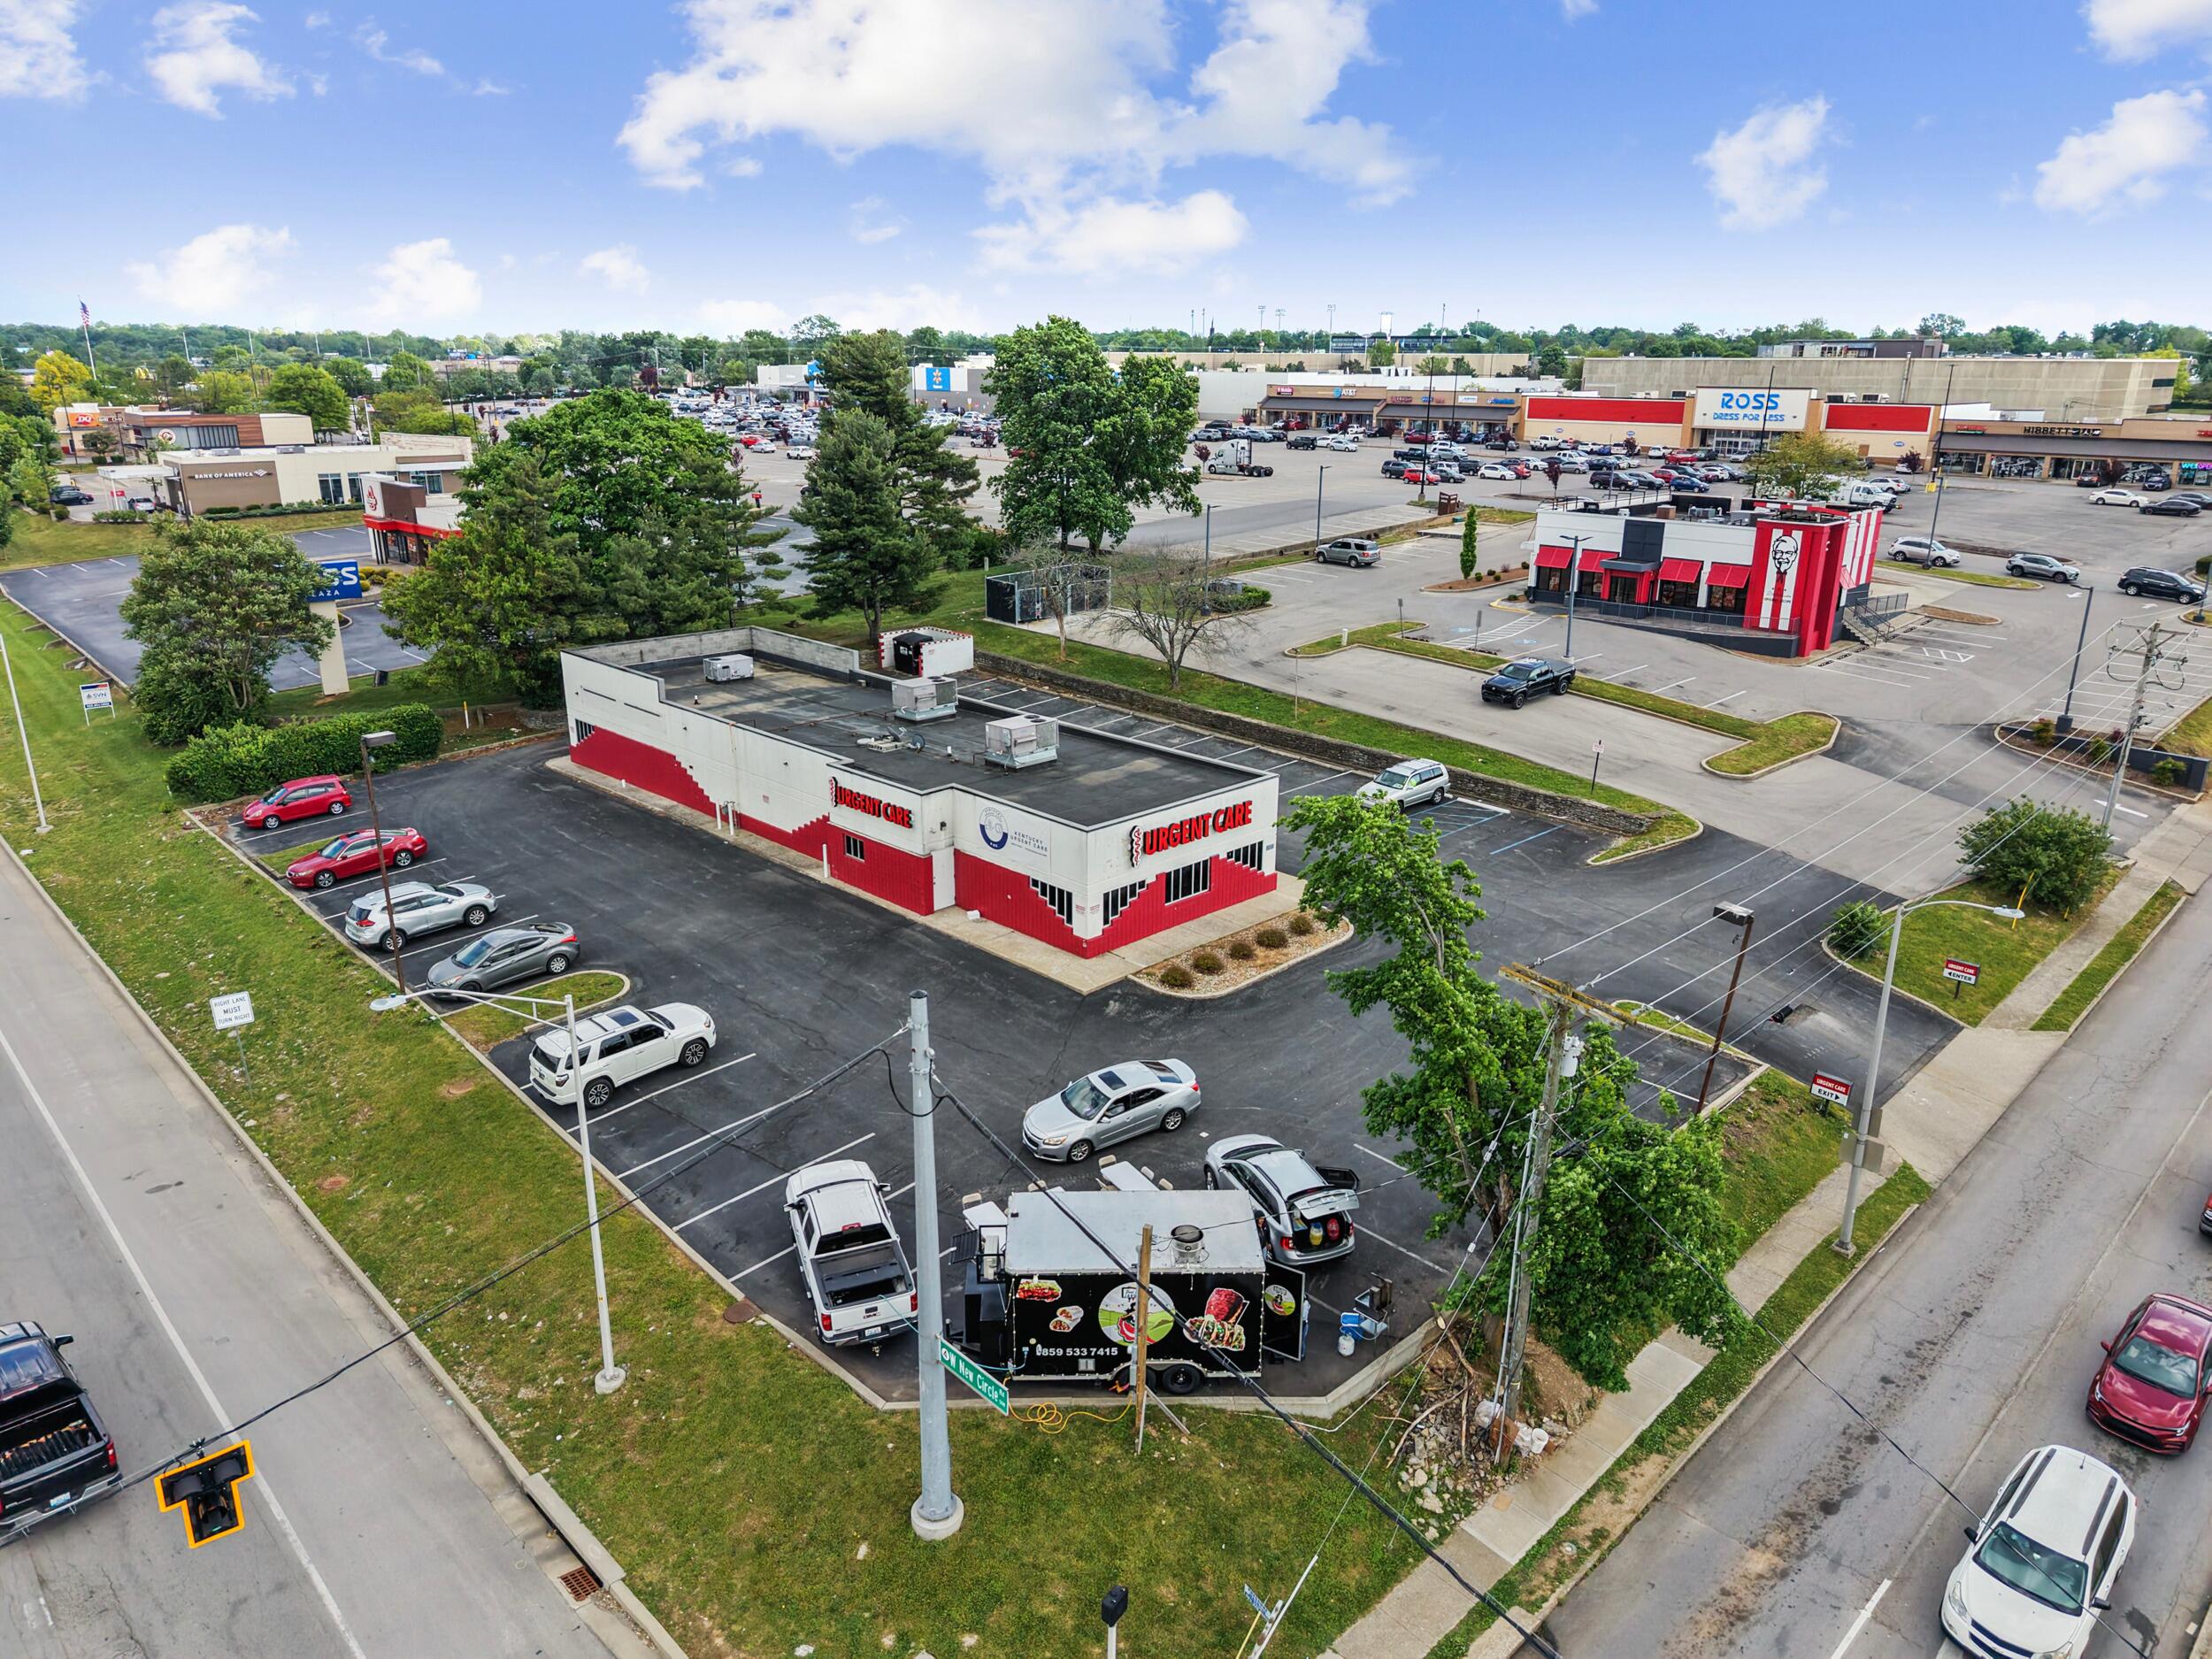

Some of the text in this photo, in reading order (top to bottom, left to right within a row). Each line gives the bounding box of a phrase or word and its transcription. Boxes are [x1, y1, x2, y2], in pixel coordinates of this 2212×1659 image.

[1721, 393, 1780, 410] ROSS
[1742, 412, 1760, 421] FOR
[836, 786, 913, 828] URGENT CARE
[1143, 800, 1253, 856] URGENT CARE
[1014, 831, 1042, 844] KENTUCKY
[1010, 835, 1032, 846] URGENT
[1033, 843, 1048, 852] CARE
[1953, 972, 1972, 981] ENTER
[223, 1006, 241, 1015] MUST
[1816, 1079, 1834, 1088] URGENT
[1818, 1088, 1834, 1098] EXIT
[1042, 1348, 1064, 1356] 859
[1090, 1347, 1118, 1356] 7415
[949, 1351, 956, 1368] W
[959, 1358, 974, 1383] New
[977, 1373, 999, 1402] Circle
